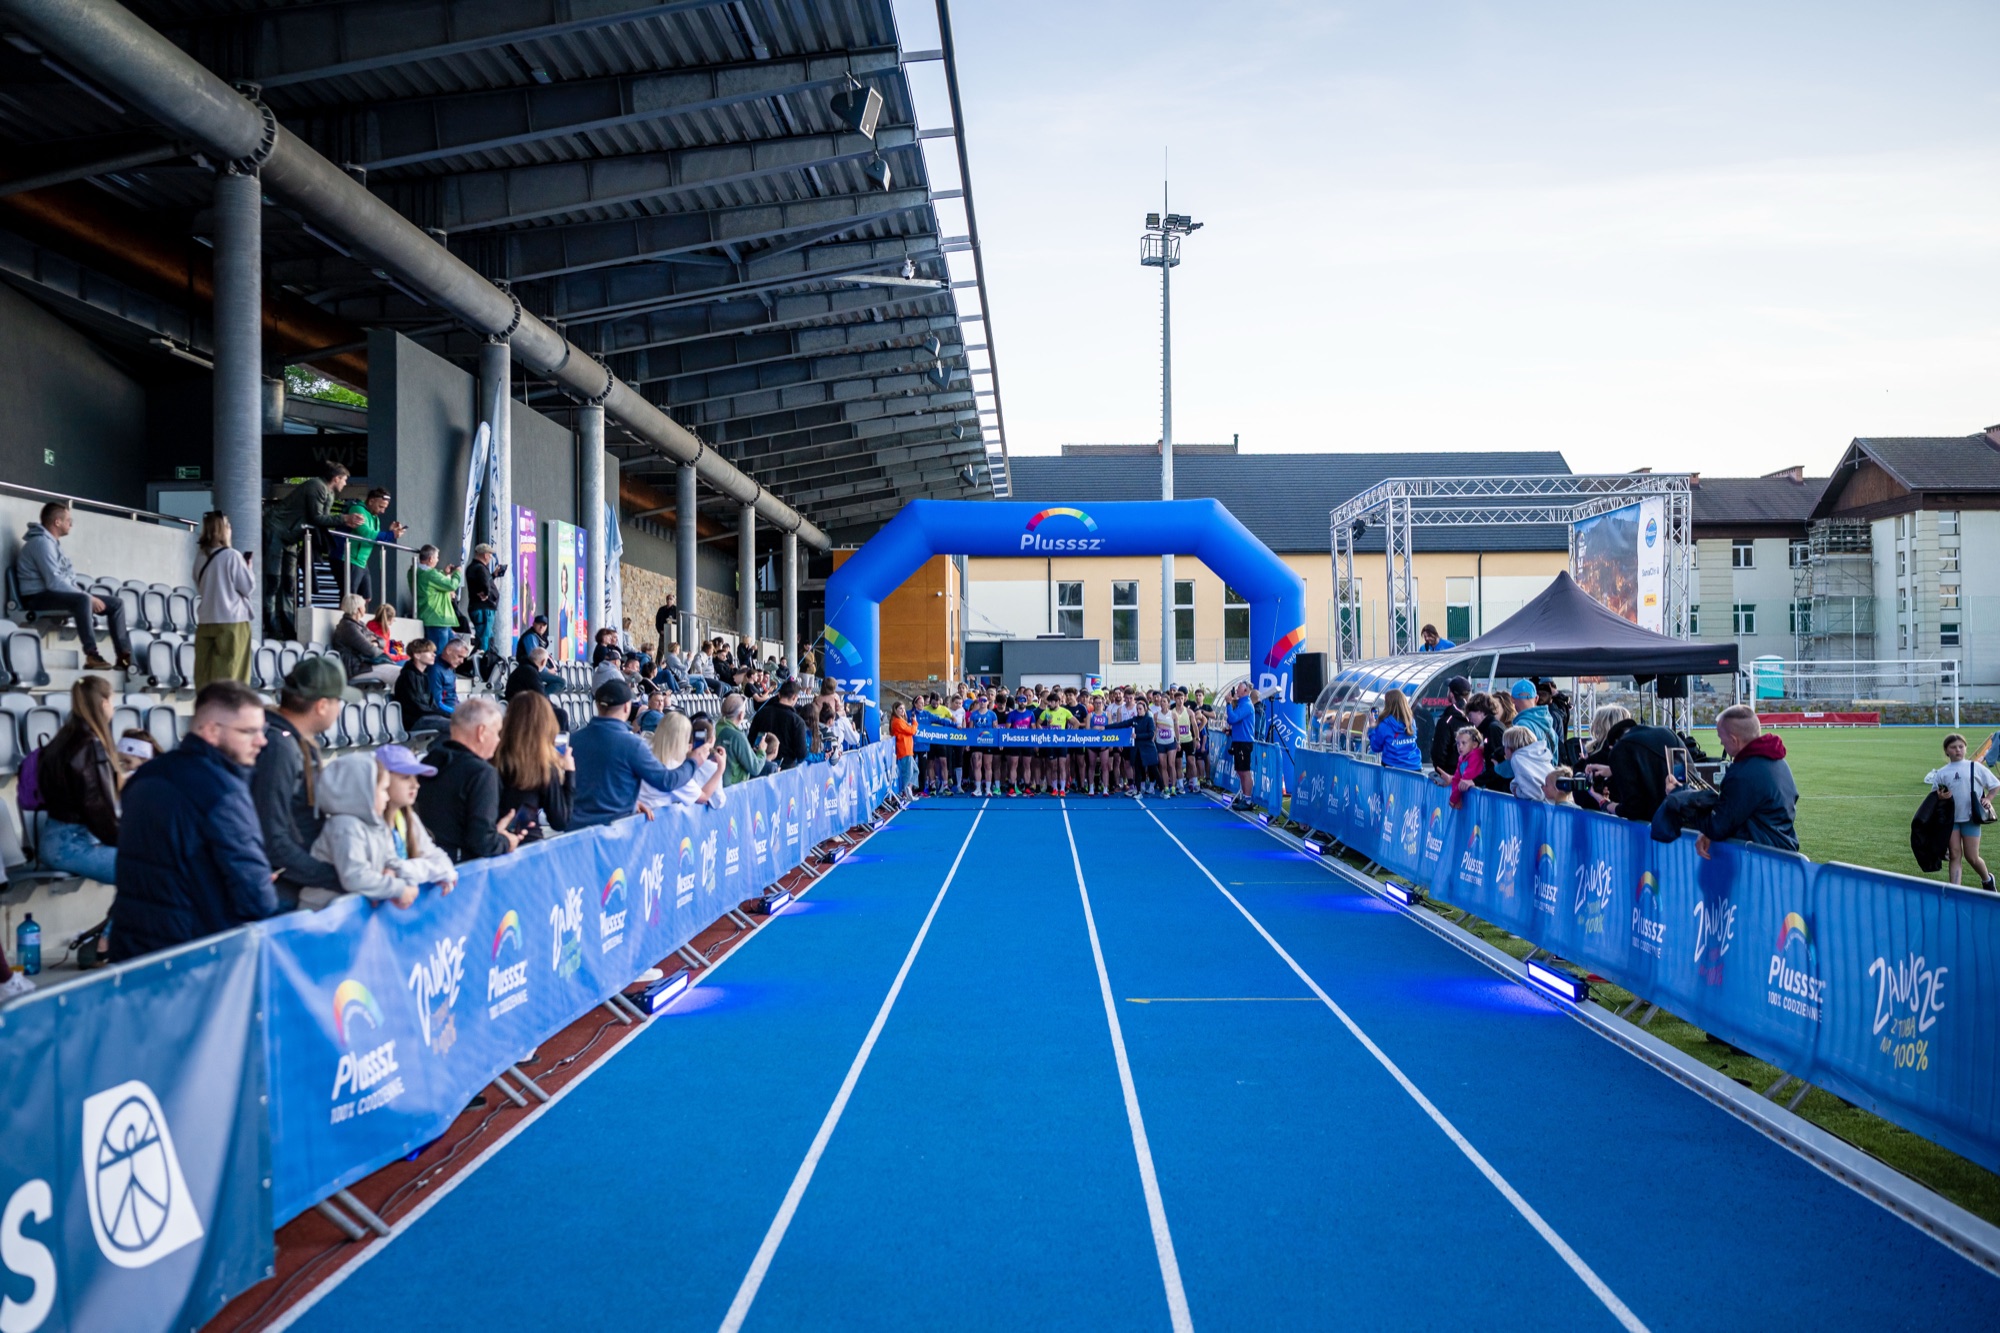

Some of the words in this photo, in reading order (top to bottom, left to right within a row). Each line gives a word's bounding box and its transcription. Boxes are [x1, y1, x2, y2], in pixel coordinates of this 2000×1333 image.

[1020, 533, 1101, 551] Plusssz
[1031, 733, 1051, 744] Night
[1053, 734, 1065, 743] Run
[1067, 733, 1100, 744] Zakopane
[1574, 858, 1612, 915] ZAWSZE
[1632, 907, 1664, 943] Plusssz
[1693, 895, 1737, 963] ZAWSZE
[408, 935, 467, 1048] ZAWSZE
[1767, 990, 1782, 1007] 100%
[1768, 954, 1823, 1004] Plusssz
[1869, 951, 1948, 1036] ZAWSZE
[1893, 1039, 1929, 1072] 100%
